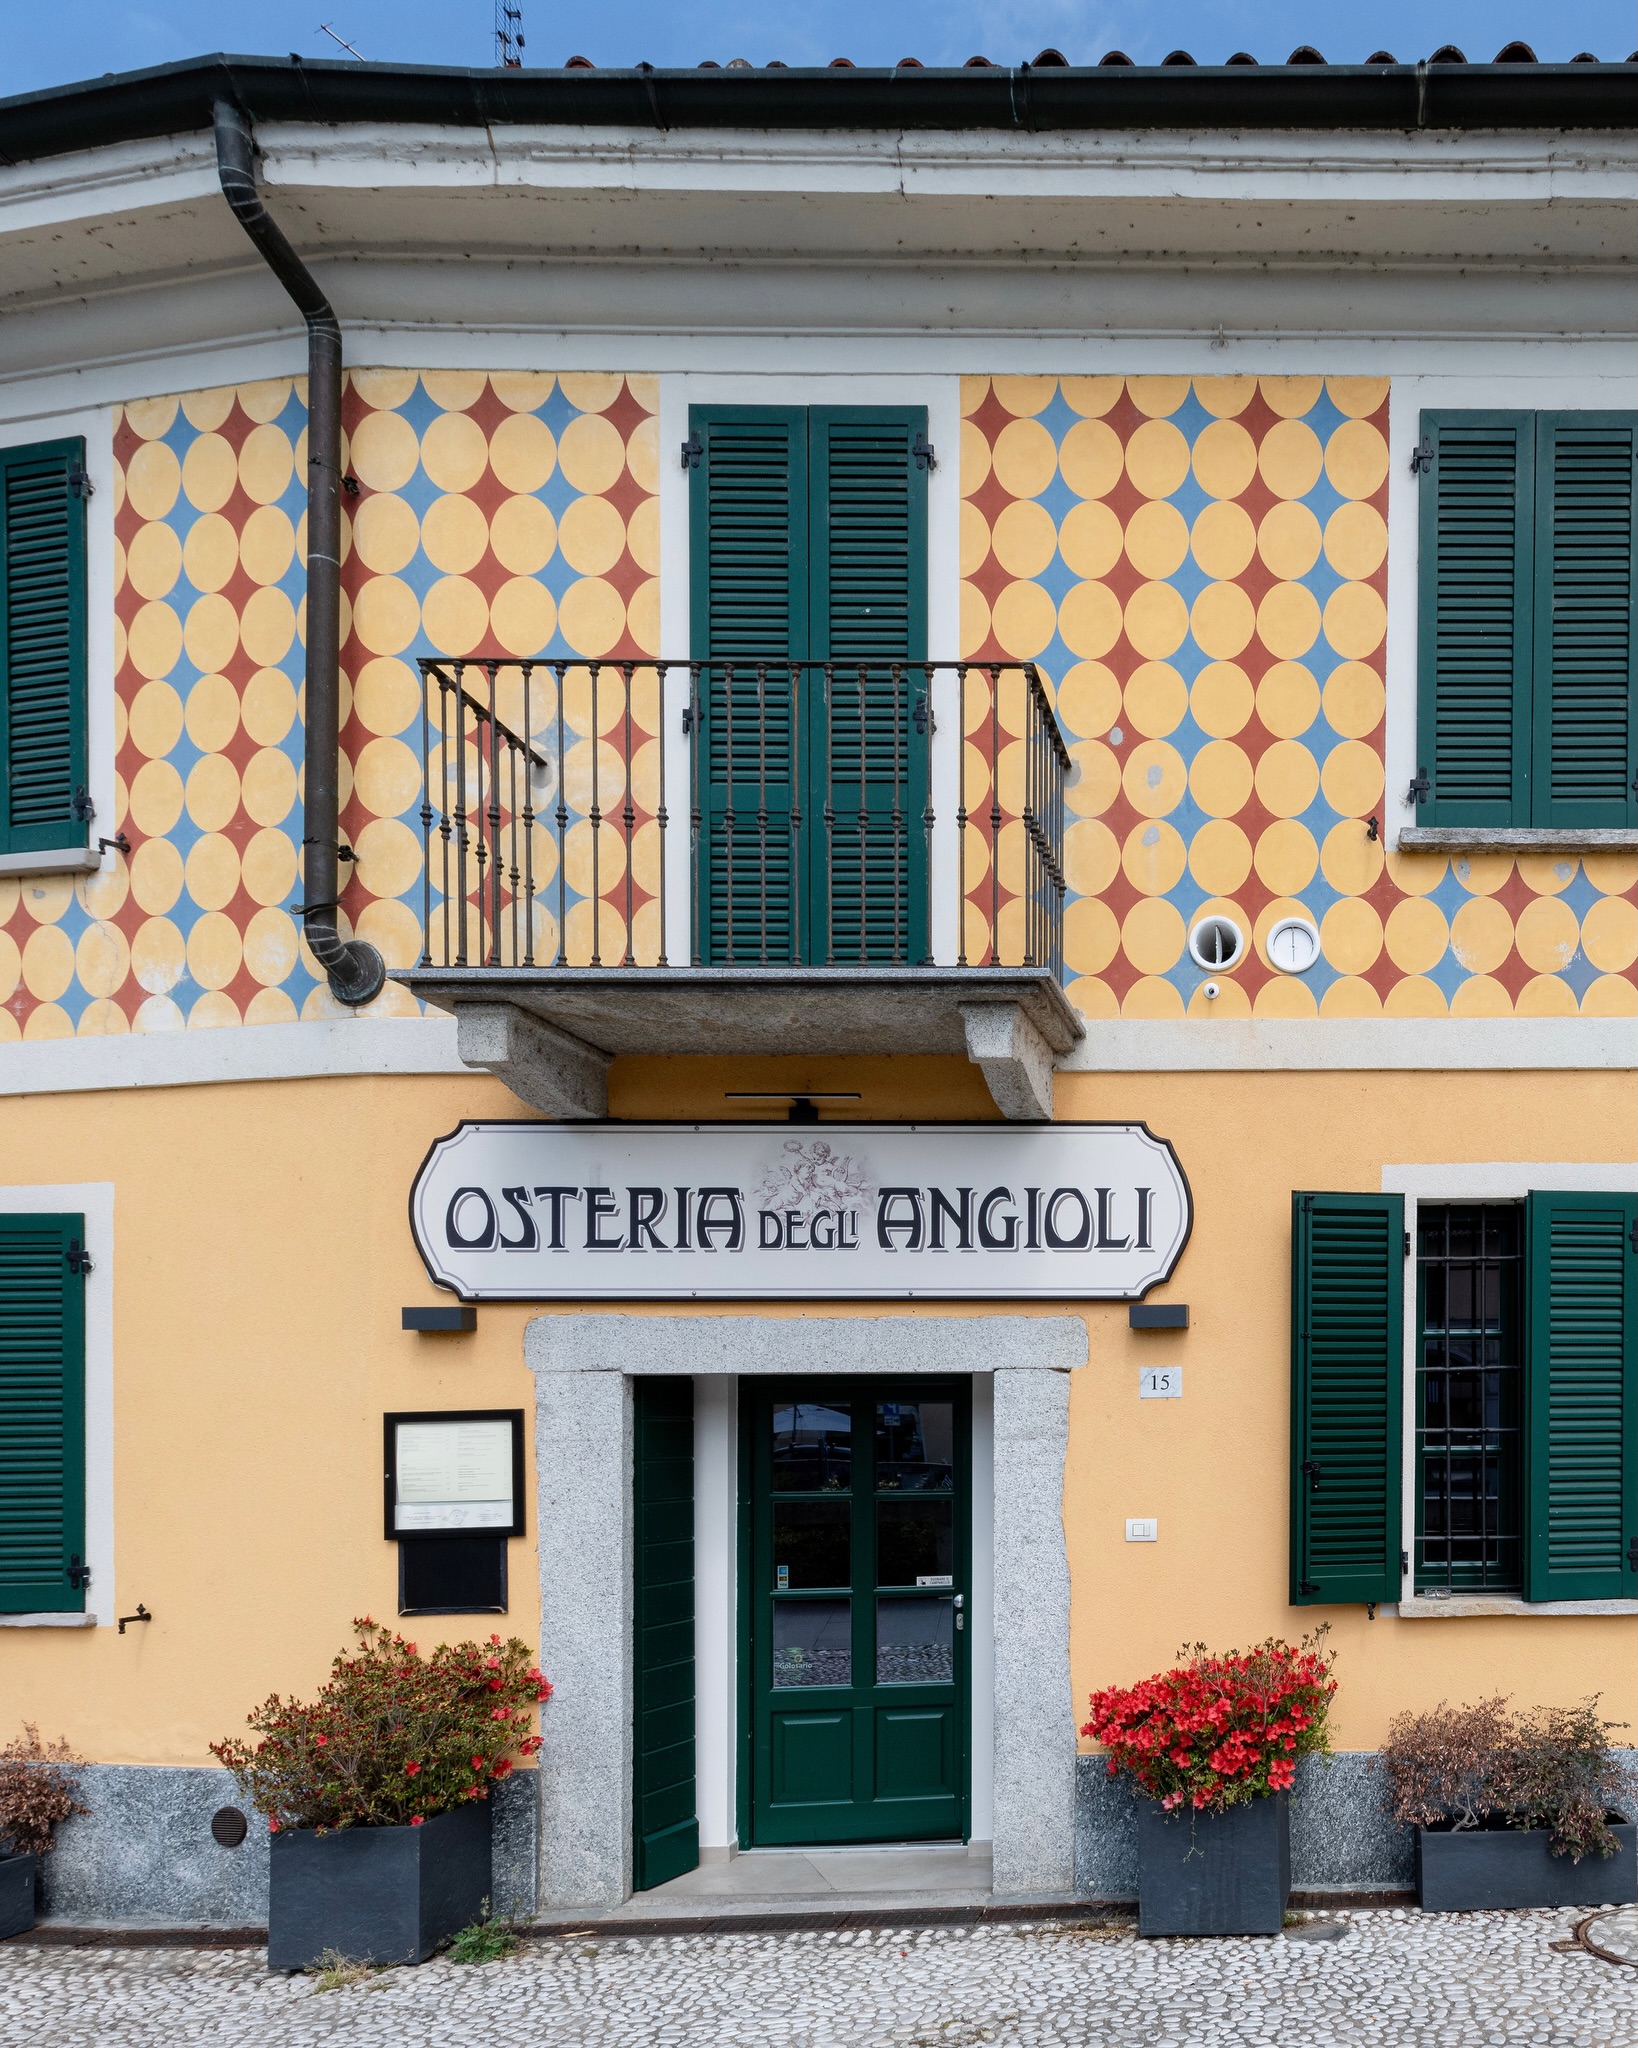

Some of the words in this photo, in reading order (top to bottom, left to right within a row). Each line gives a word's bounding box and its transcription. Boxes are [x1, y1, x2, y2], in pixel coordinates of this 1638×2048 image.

[445, 1186, 746, 1253] OSTERIA
[757, 1209, 861, 1251] DEGLI
[877, 1186, 1157, 1253] ANGIOLI
[1151, 1374, 1170, 1391] 15
[779, 1662, 813, 1670] Golosario
